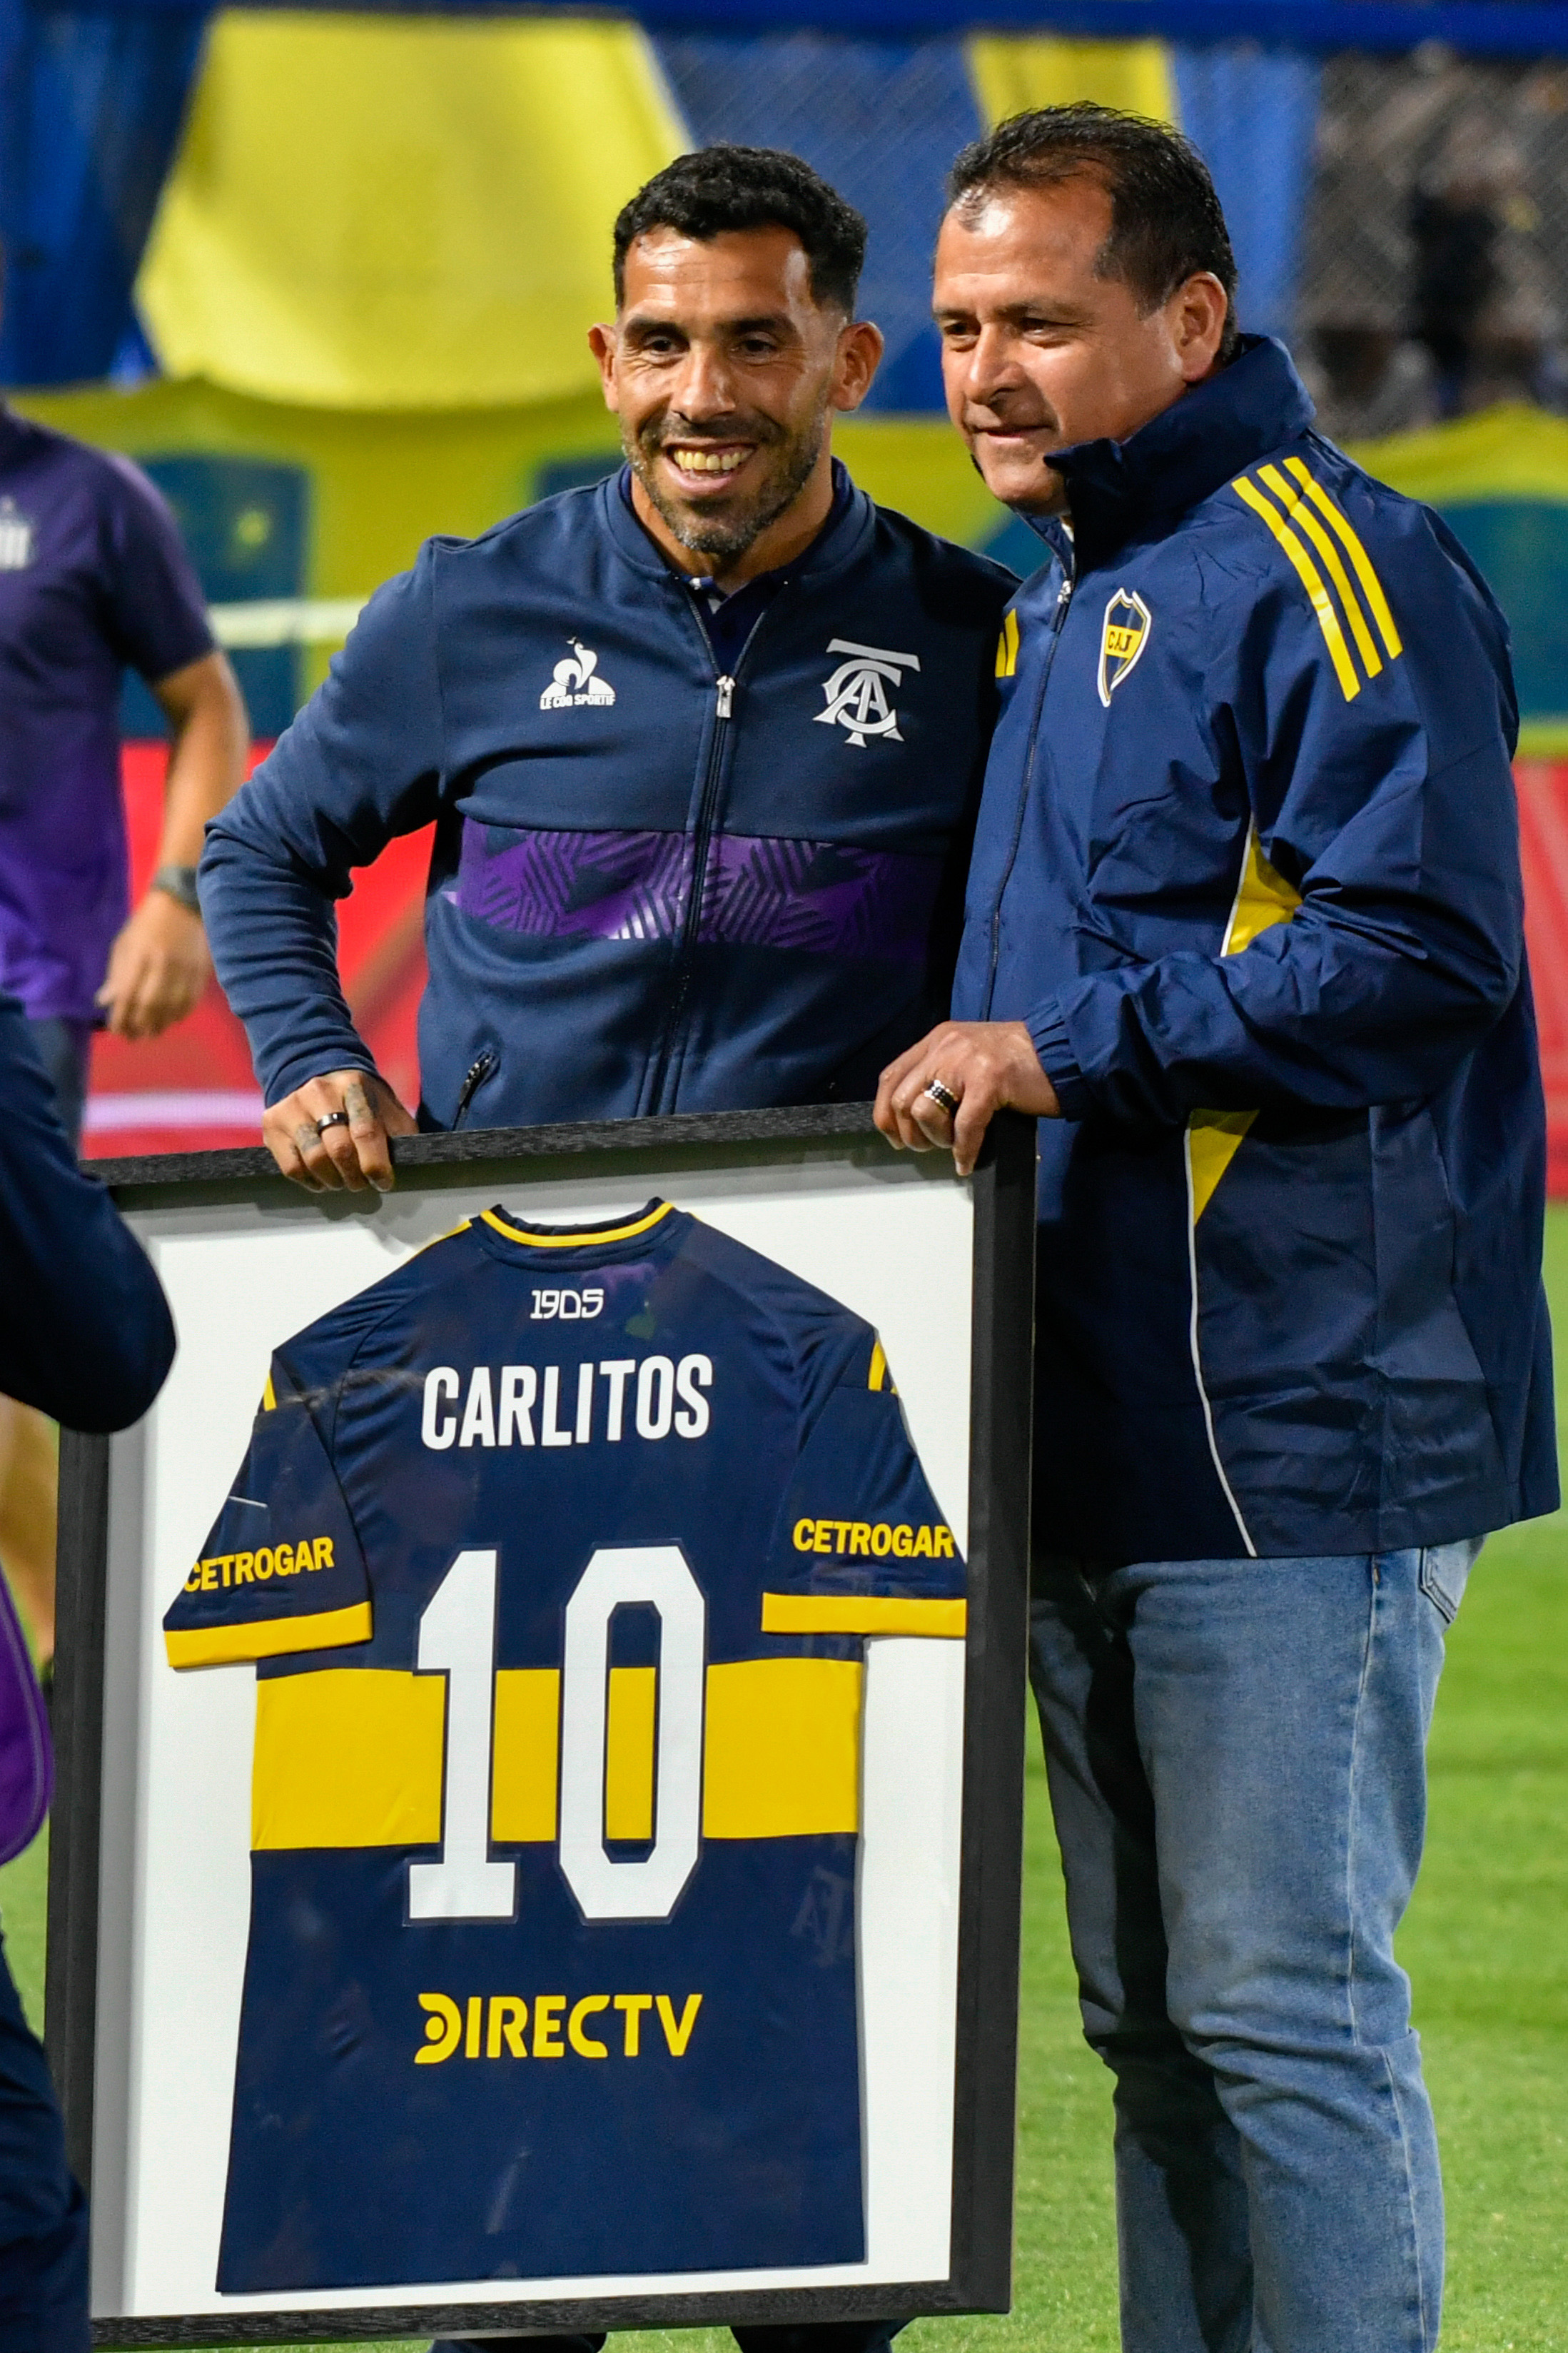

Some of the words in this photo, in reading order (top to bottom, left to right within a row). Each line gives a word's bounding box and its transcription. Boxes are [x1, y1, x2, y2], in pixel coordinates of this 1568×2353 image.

[540, 697, 552, 710] LE
[574, 694, 616, 706] SPORTIF
[530, 1289, 604, 1319] 1905
[421, 1354, 712, 1450] CARLITOS
[792, 1518, 955, 1558] CETROGAR
[409, 1546, 705, 1918] 10
[414, 1992, 703, 2065] DIRECTV
